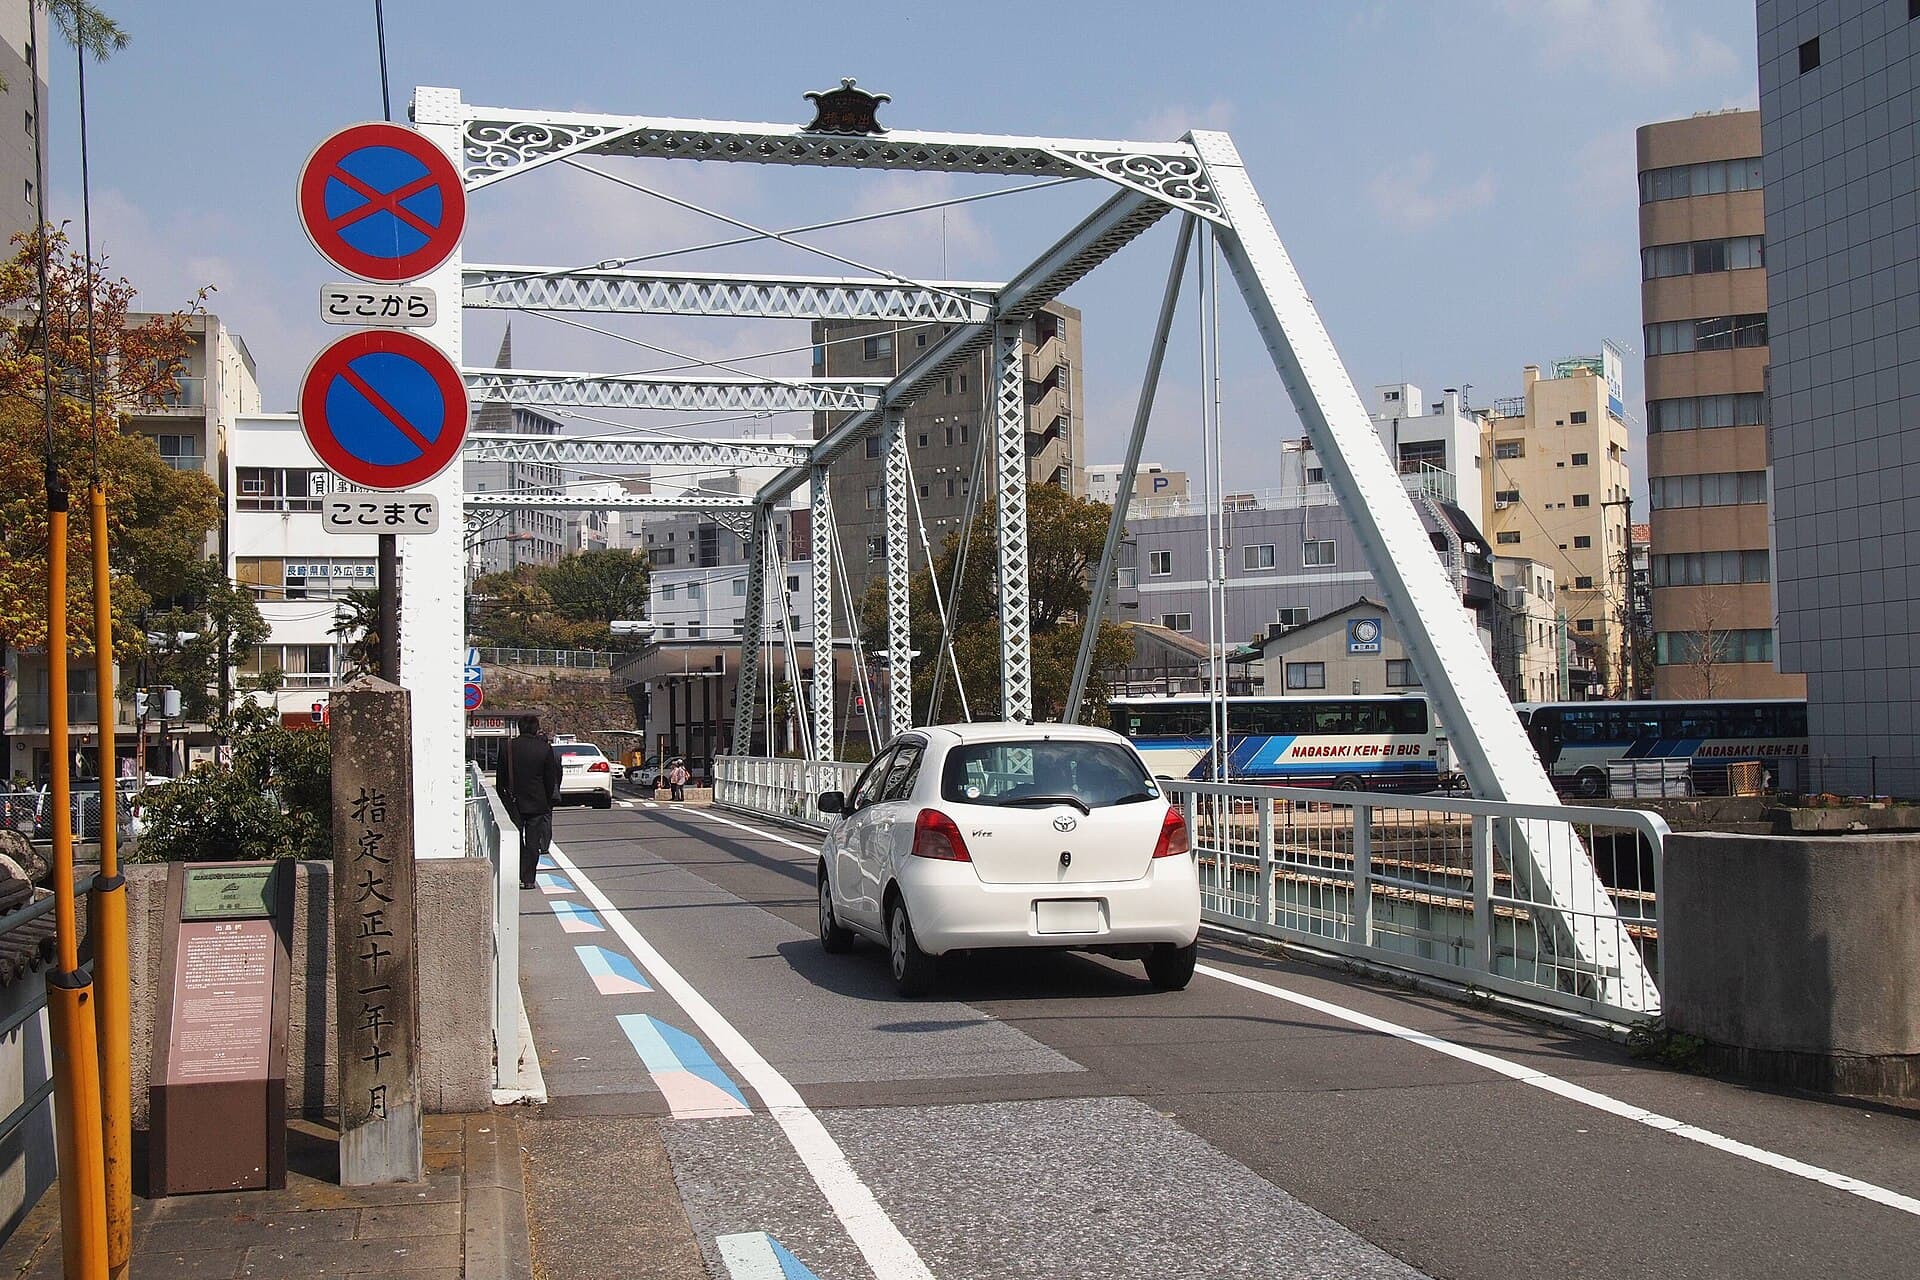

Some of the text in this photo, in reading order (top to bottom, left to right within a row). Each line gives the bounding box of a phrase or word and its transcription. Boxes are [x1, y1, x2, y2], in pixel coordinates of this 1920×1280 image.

[329, 293, 429, 318] ここから
[1153, 477, 1169, 493] P
[331, 502, 432, 526] ここまで
[1291, 744, 1421, 758] NAGASAKI KEN-EI BUS
[1698, 745, 1754, 757] NAGASAKI
[1757, 744, 1798, 756] KEN-EI
[350, 786, 395, 1122] 指定大正十一年十月
